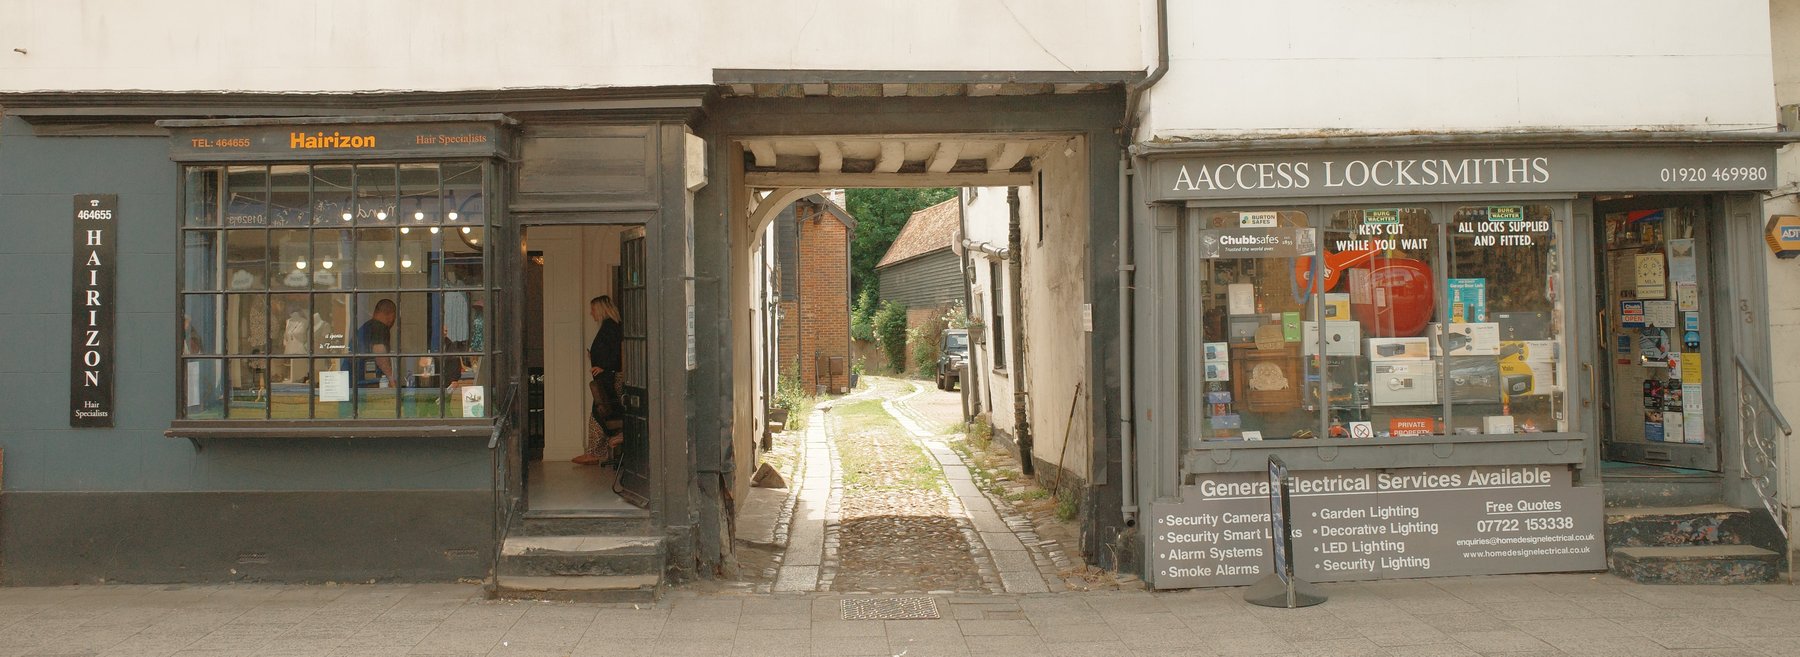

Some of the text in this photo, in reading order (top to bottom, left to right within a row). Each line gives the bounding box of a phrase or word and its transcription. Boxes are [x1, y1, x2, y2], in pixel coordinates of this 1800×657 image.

[192, 138, 250, 148] TEL: 464655
[290, 132, 376, 149] Hairizon
[416, 134, 487, 145] Hair Specialists
[1172, 157, 1550, 191] AACCESS LOCKSMITHS
[1660, 166, 1767, 182] 01920 469980
[78, 210, 112, 220] 464655
[1359, 224, 1404, 235] KEYS CUT
[1459, 221, 1549, 232] ALL LOCKS SUPPLIED
[1782, 229, 1800, 238] ADT
[1220, 235, 1279, 245] Chubbsafes
[1336, 239, 1428, 251] WHILE YOU WAIT
[1474, 235, 1534, 246] AND FITTED.
[84, 230, 103, 387] HAIRIZON
[75, 409, 108, 419] Specialists
[1200, 467, 1551, 496] Genera Electrical Services Available
[1320, 505, 1419, 519] Garden Lighting
[1486, 500, 1561, 512] Free Quotes
[1166, 512, 1271, 527] Security Camera
[1477, 517, 1574, 533] 07722 153338
[1167, 528, 1302, 544] Security Smart Lks
[1321, 522, 1438, 536] Decorative Lighting
[1322, 540, 1404, 554] LED Lighting
[1456, 534, 1594, 547] enquiries@homedesignelectrical.co.uk
[1168, 547, 1263, 561] Alarm Systems
[1463, 546, 1590, 558] www.homedesignelectrical.co.uk
[1324, 556, 1430, 571] Security Lighting
[1169, 564, 1260, 578] Smoke Alarms
